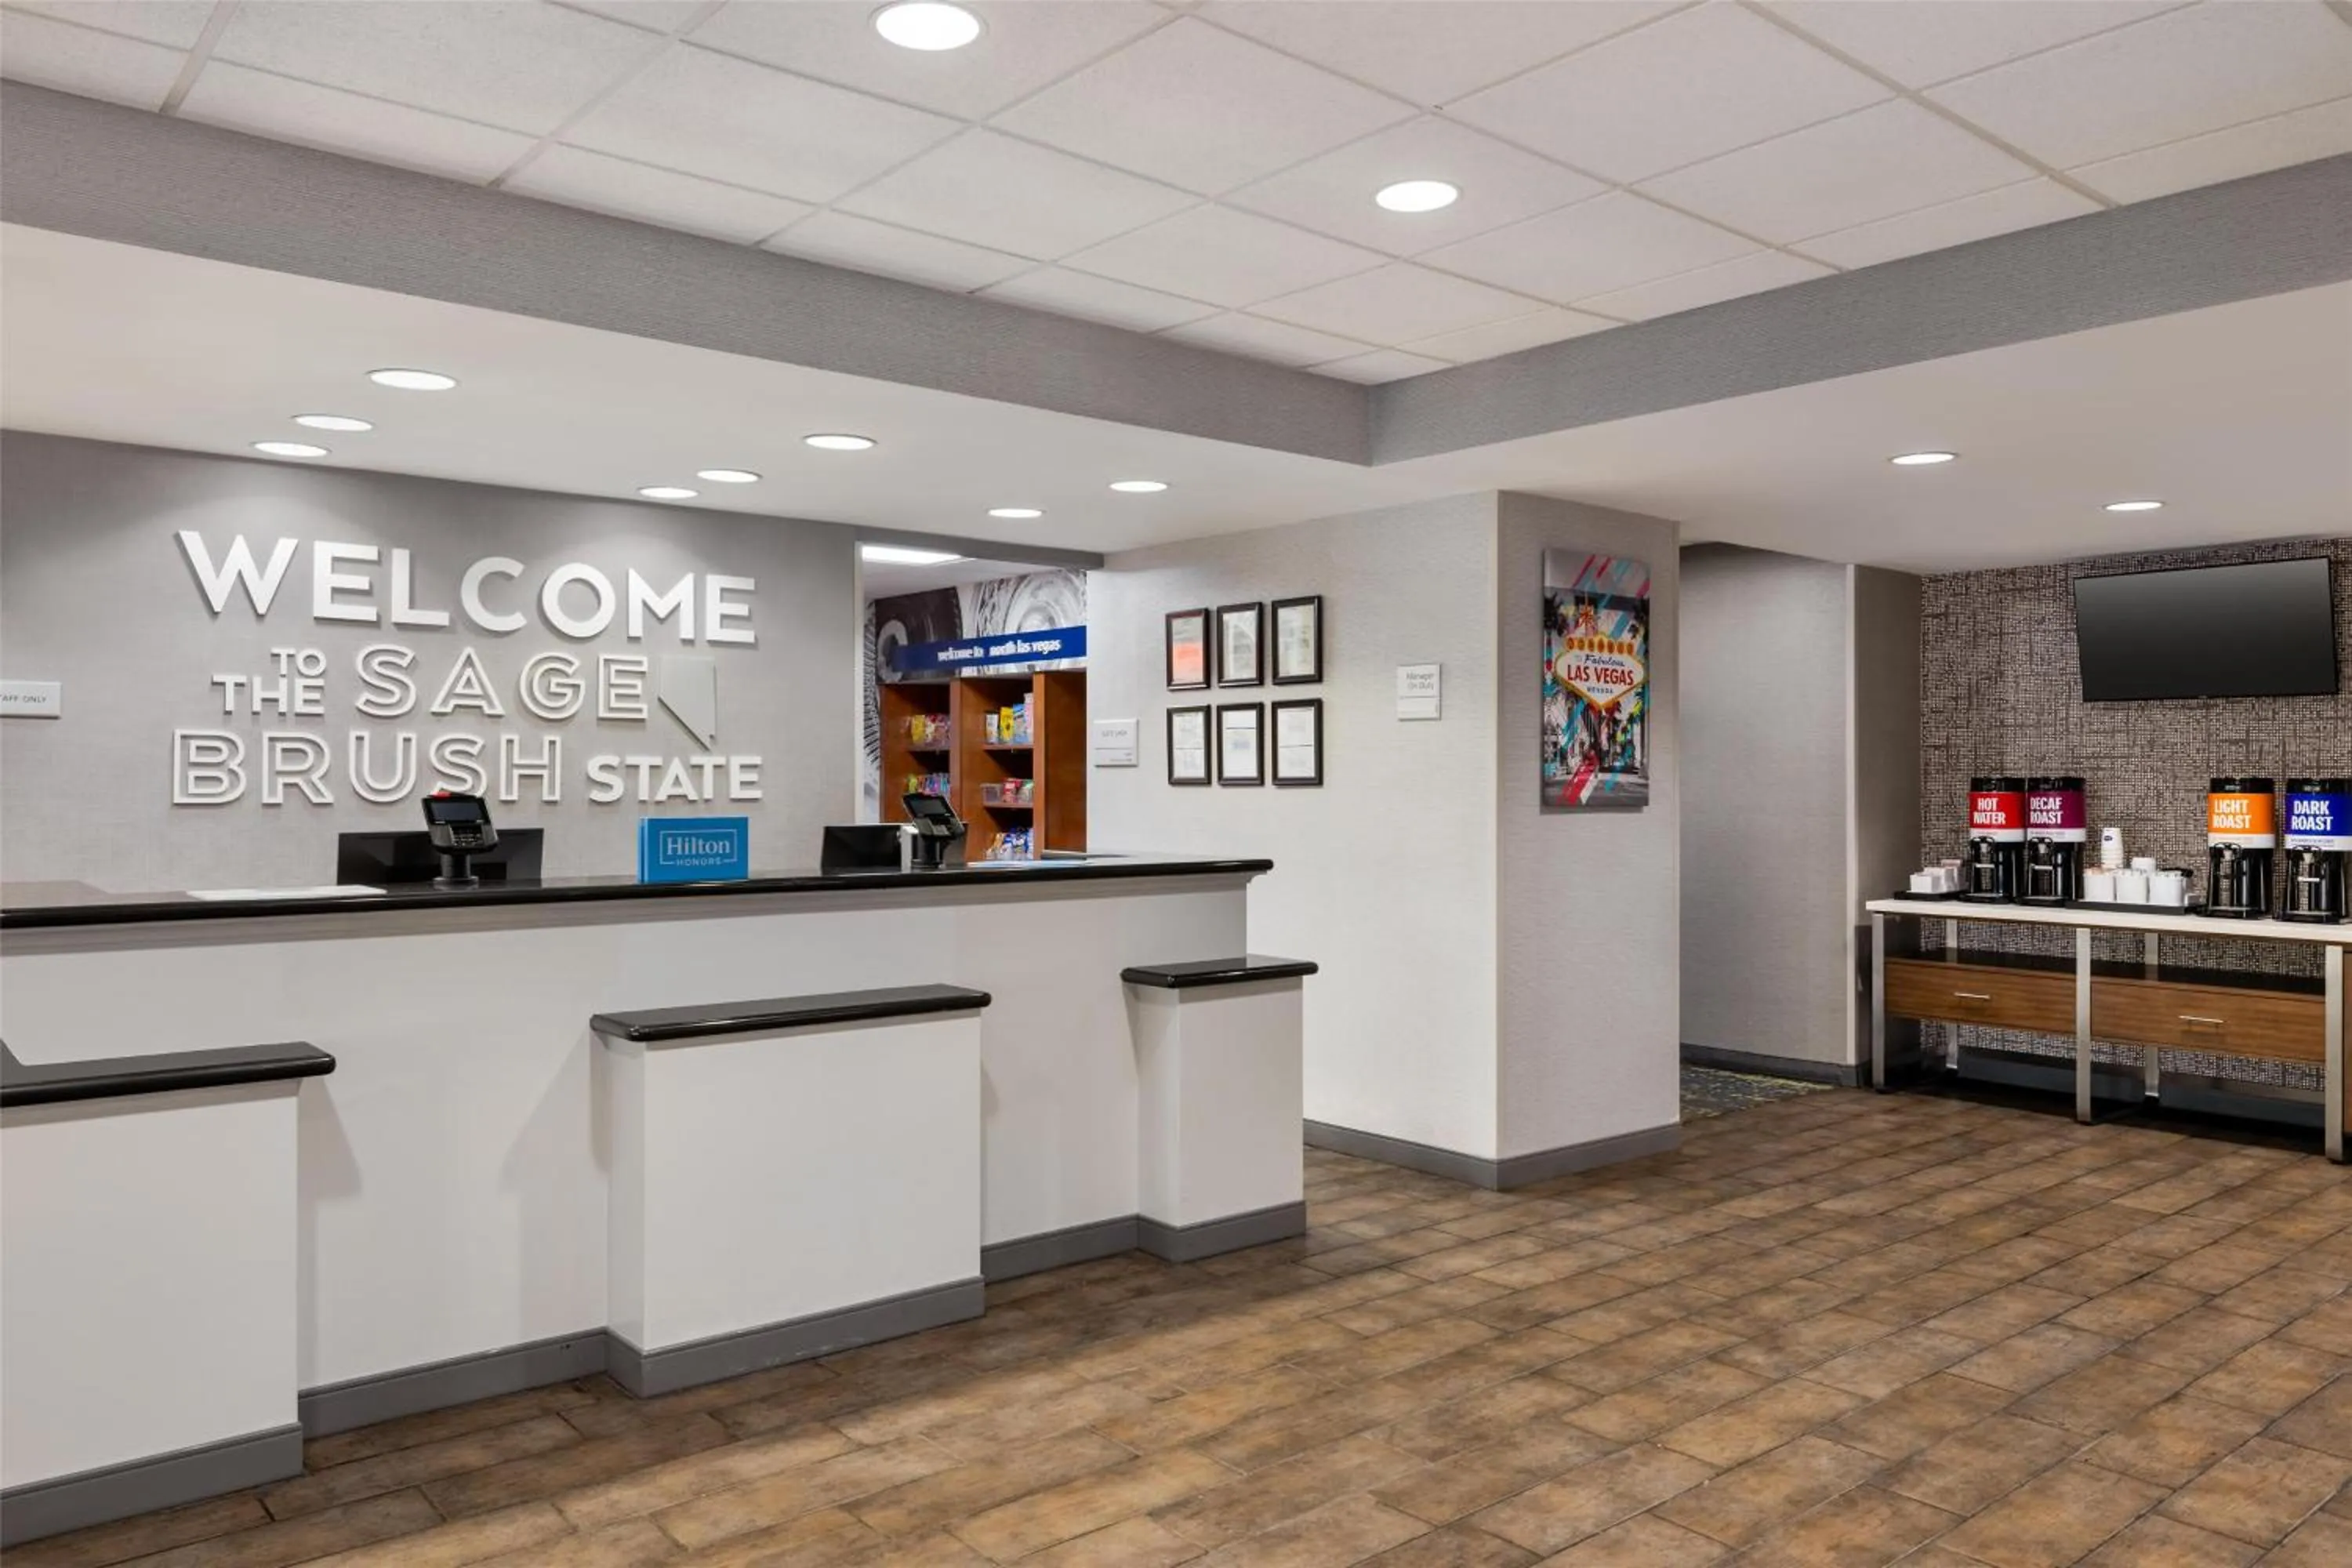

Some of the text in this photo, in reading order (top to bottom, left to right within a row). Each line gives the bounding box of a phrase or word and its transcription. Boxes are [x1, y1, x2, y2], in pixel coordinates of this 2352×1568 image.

[178, 530, 756, 644] WELCOME
[1032, 639, 1062, 655] vegas
[270, 648, 327, 677] TO
[212, 644, 648, 720] THE SAGE
[1567, 664, 1635, 686] LAS VEGAS
[23, 695, 46, 703] ONLY
[173, 728, 763, 804] BRUSH STATE
[1977, 797, 1998, 811] HOT
[2030, 797, 2062, 810] DECAF
[2214, 798, 2249, 814] LIGHT
[2293, 800, 2330, 815] DARK
[1973, 811, 2006, 825] WATER
[2030, 811, 2063, 824] ROAST
[2212, 815, 2252, 829] ROAST
[2291, 815, 2333, 831] ROAST
[666, 836, 731, 855] Hilton
[677, 856, 722, 866] HONORS
